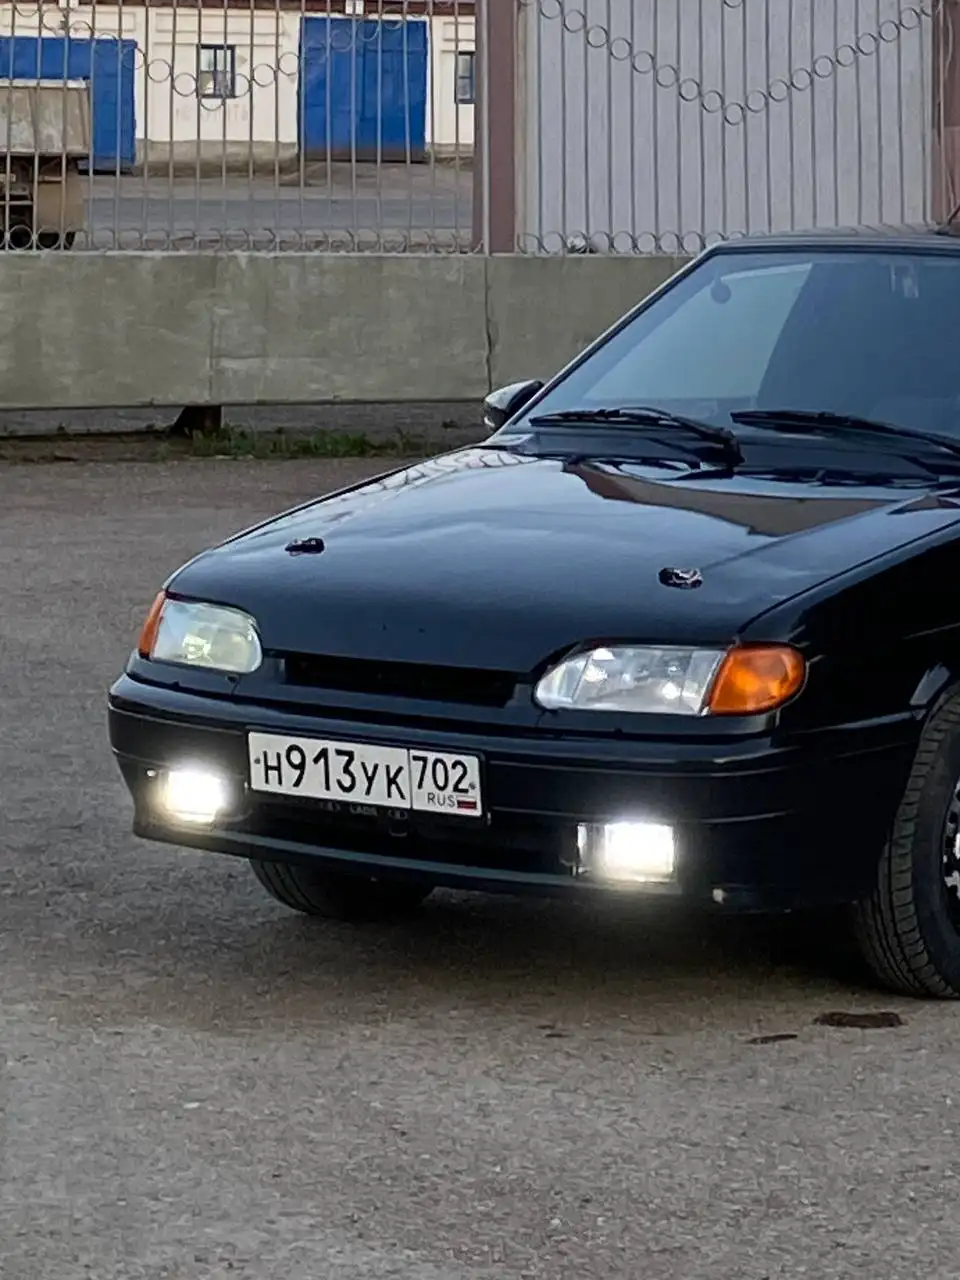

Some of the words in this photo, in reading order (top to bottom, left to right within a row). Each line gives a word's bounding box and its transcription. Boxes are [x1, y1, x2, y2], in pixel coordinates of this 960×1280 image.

[263, 743, 406, 800] Н913УК
[412, 755, 469, 794] 702
[427, 792, 456, 808] RUS
